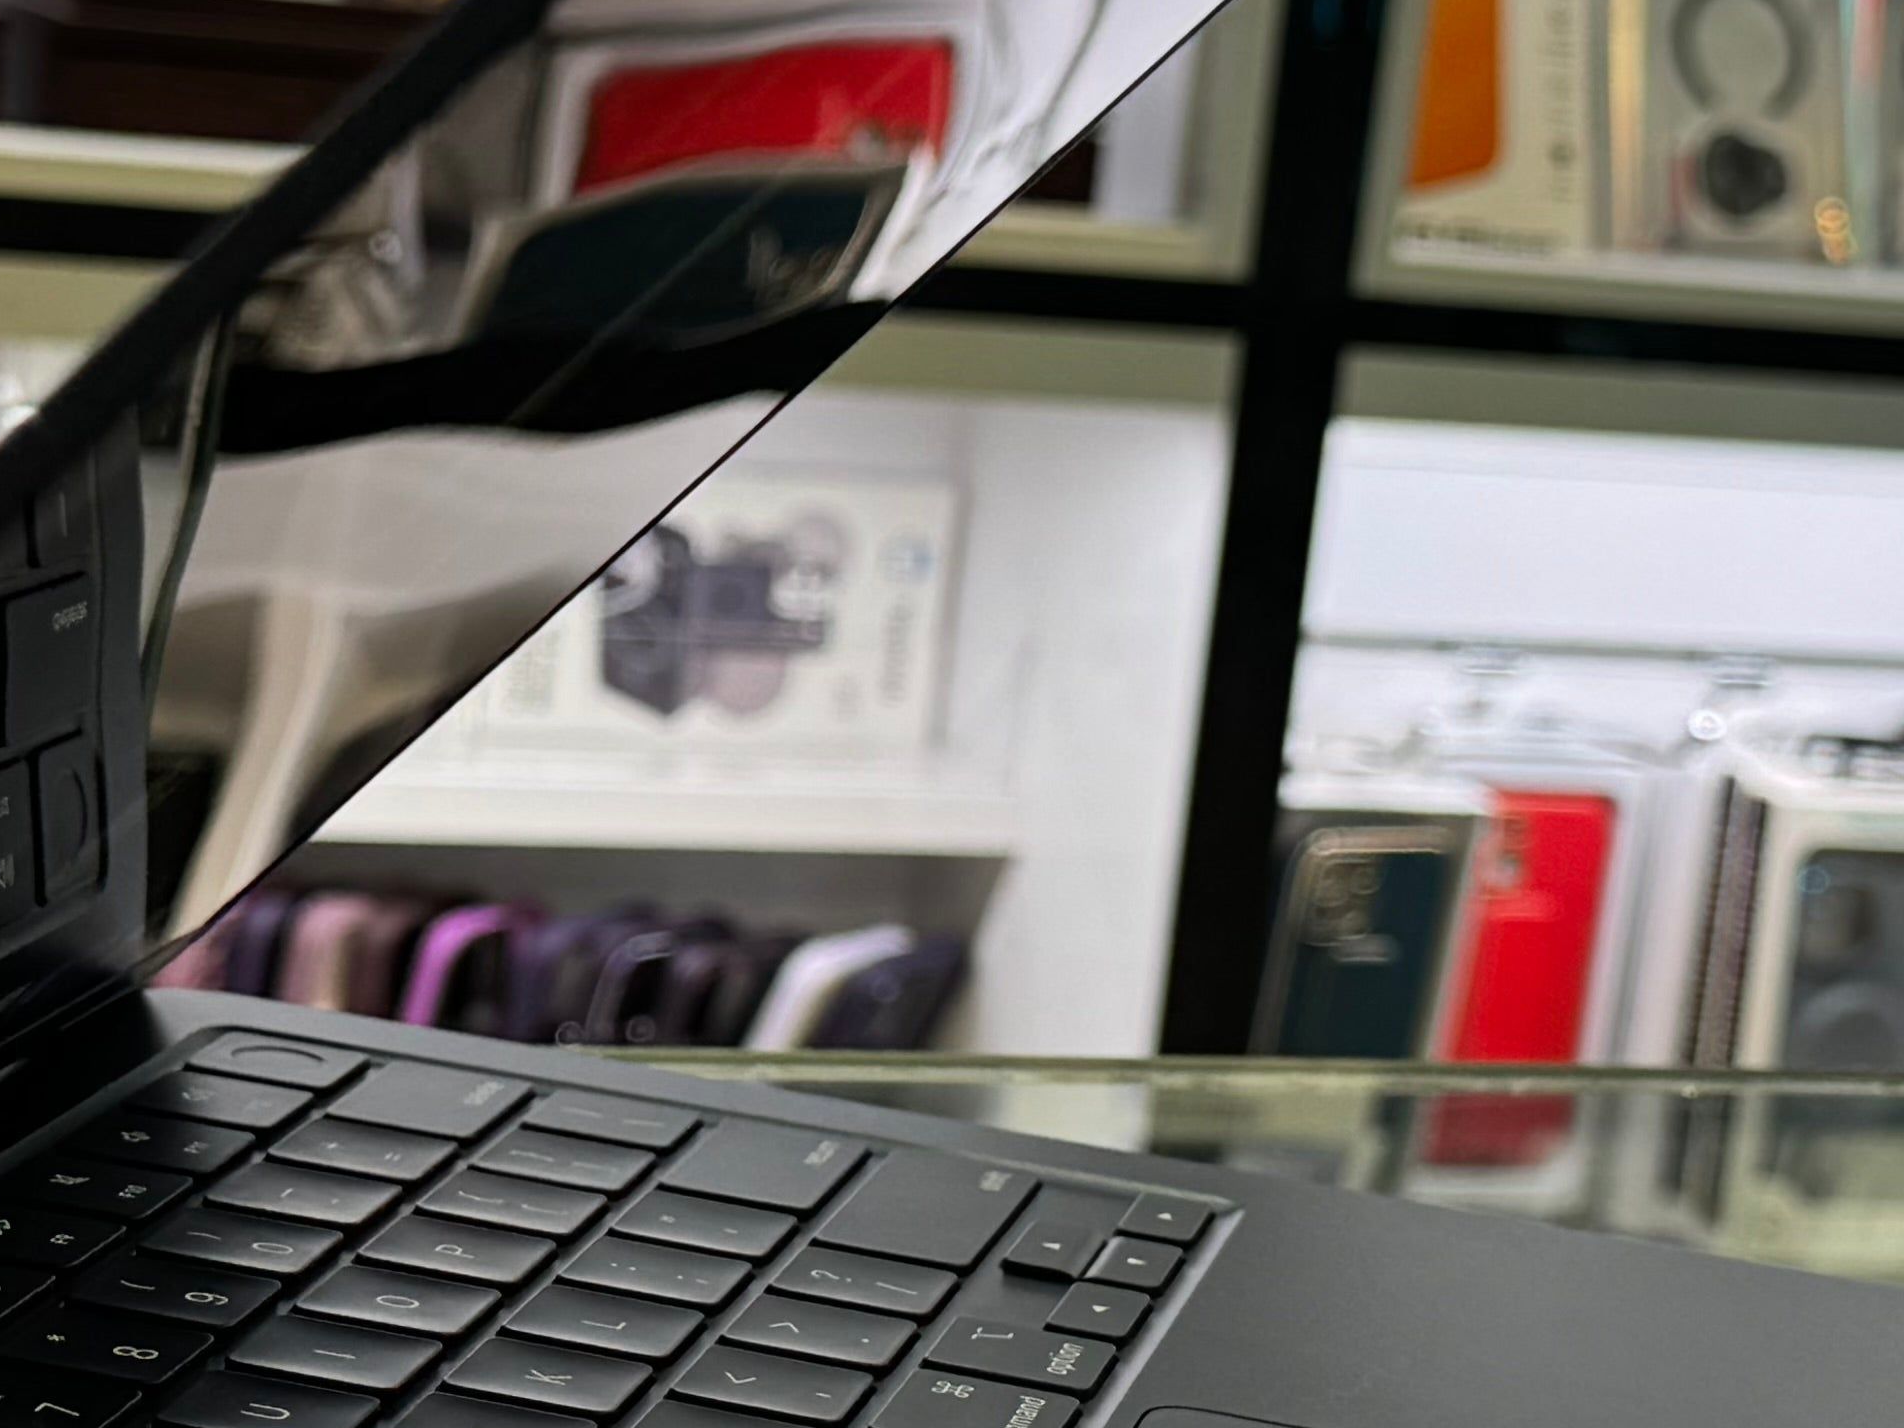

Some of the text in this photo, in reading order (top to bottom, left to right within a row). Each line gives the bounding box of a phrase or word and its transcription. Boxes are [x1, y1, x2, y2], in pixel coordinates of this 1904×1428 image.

[434, 1243, 474, 1259] P
[184, 1291, 229, 1306] 9
[581, 1320, 627, 1331] L
[112, 1345, 159, 1360] 8
[1046, 1342, 1083, 1375] option
[524, 1369, 573, 1386] K
[34, 1402, 80, 1417] 7
[240, 1402, 291, 1420] U
